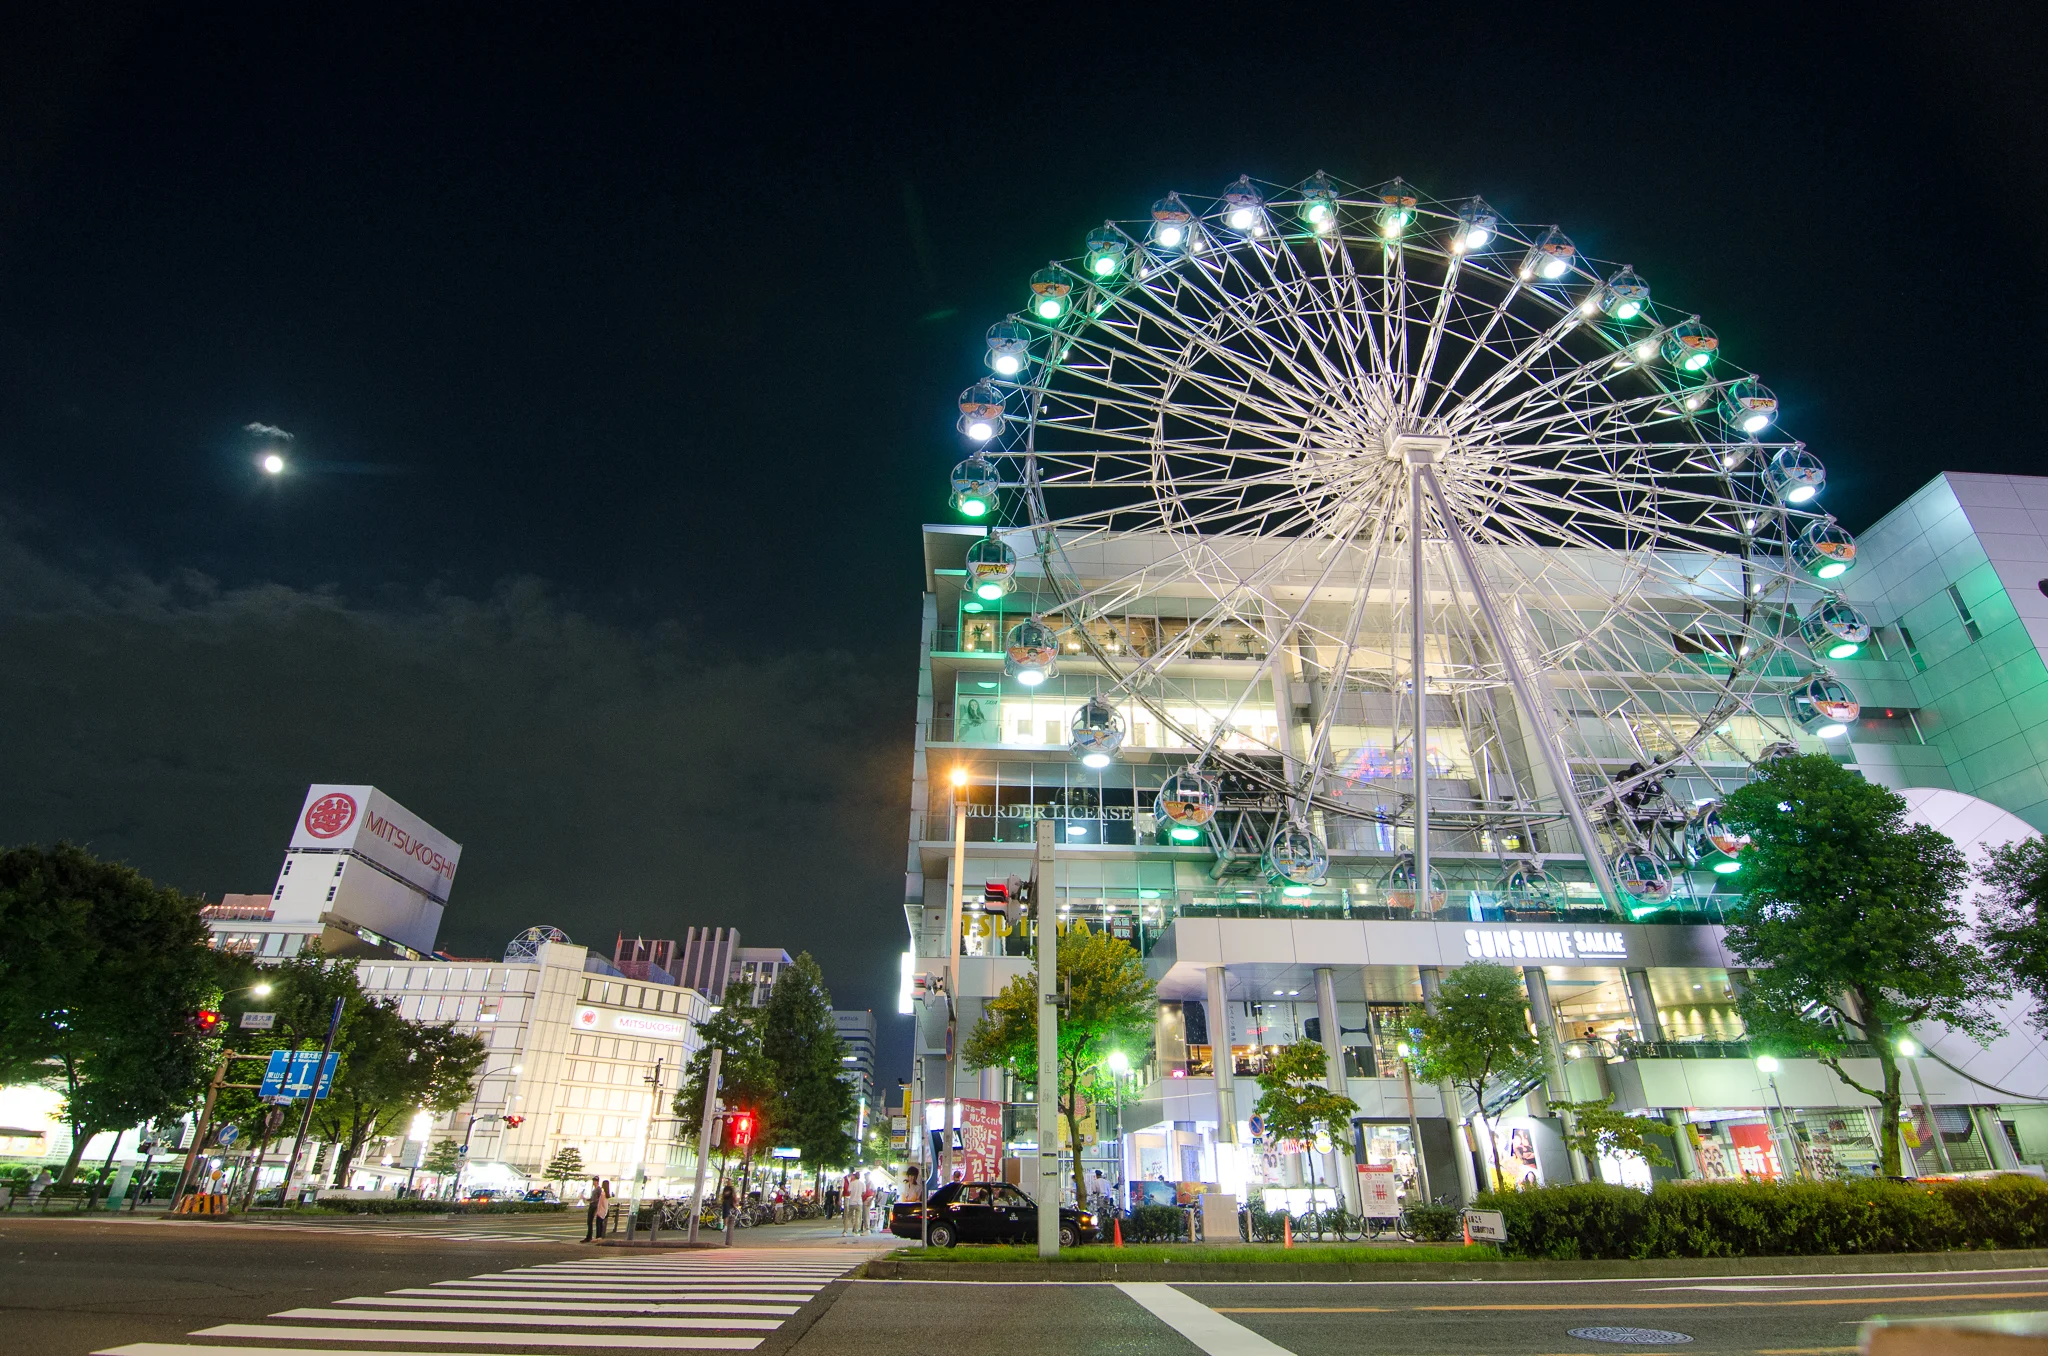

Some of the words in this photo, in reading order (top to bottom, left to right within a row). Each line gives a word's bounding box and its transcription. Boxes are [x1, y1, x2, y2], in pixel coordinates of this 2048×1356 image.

[966, 804, 1046, 819] MURDER
[1052, 806, 1133, 820] LICENSE
[365, 810, 455, 880] MITSUKOSHI
[961, 914, 1092, 938] TSUTYA
[1464, 929, 1576, 959] SUNSHINE
[1573, 930, 1627, 953] SAKAE
[619, 1018, 682, 1033] MITSUKOSHI
